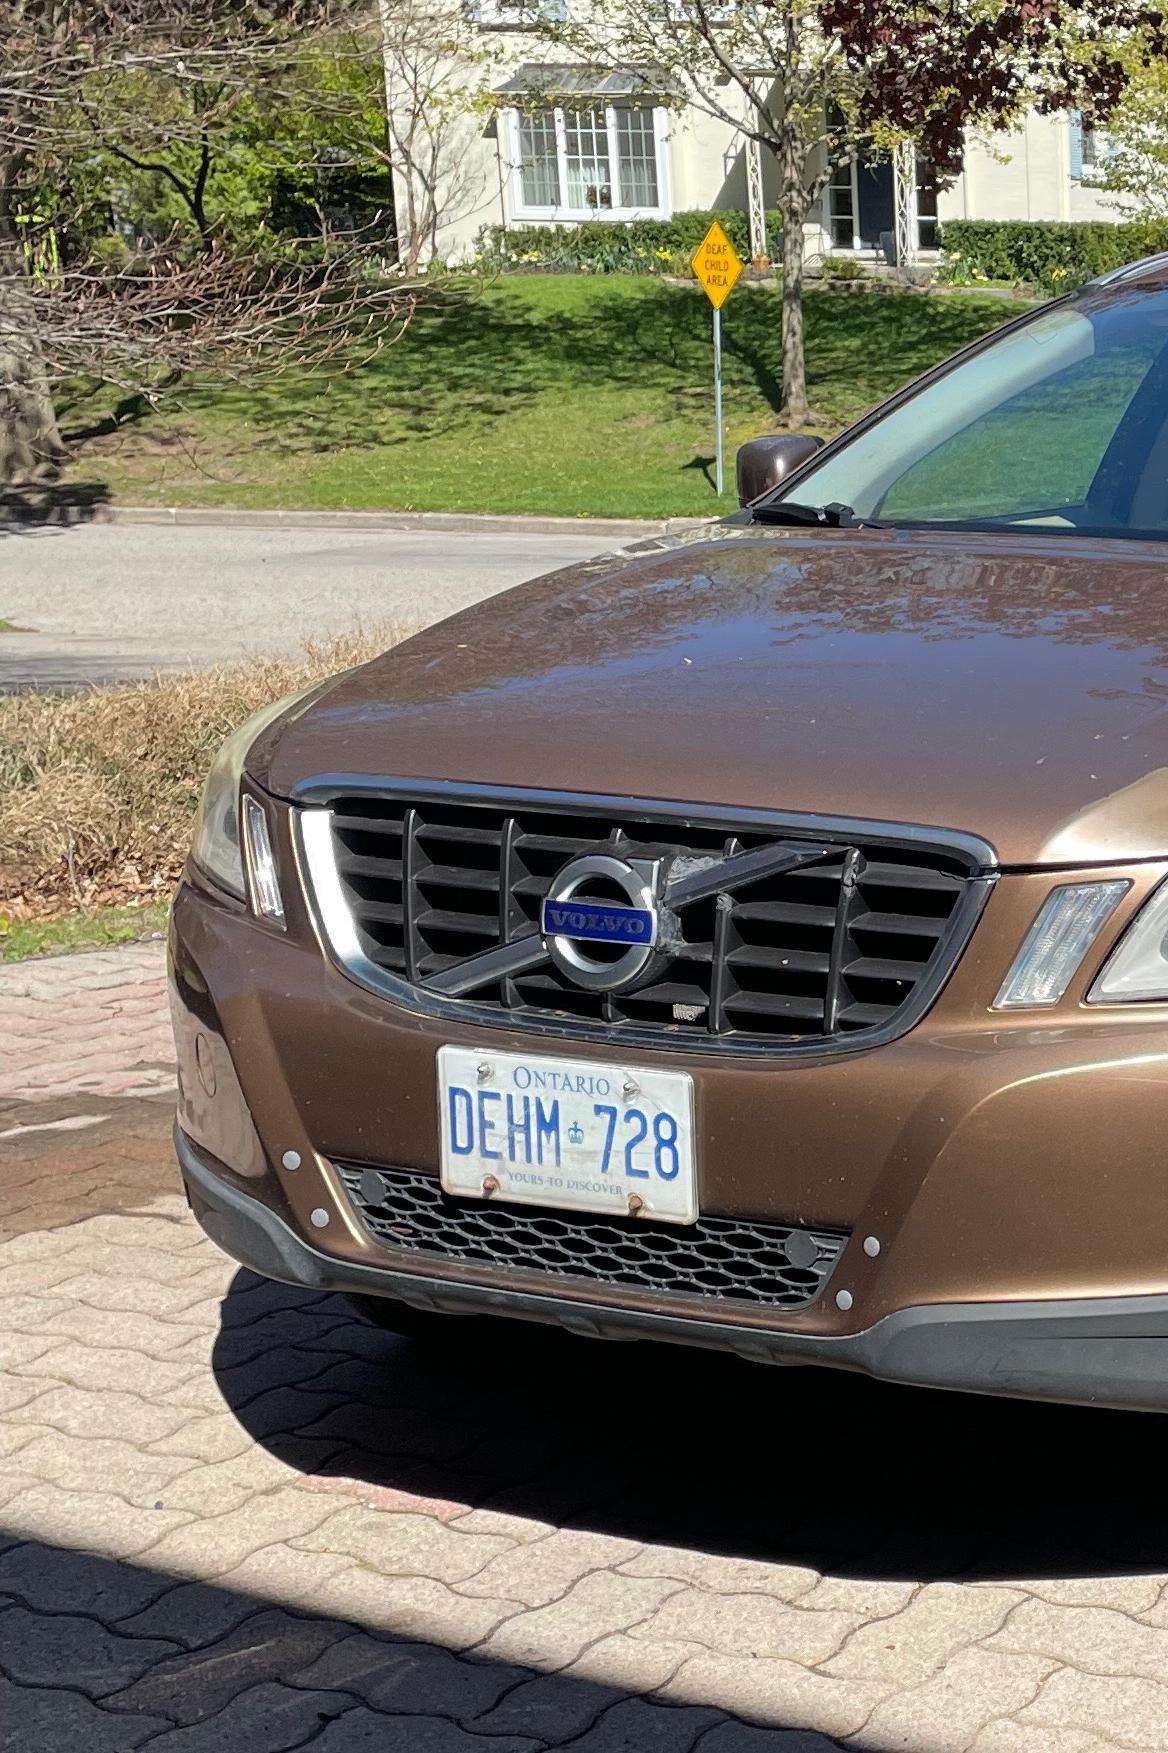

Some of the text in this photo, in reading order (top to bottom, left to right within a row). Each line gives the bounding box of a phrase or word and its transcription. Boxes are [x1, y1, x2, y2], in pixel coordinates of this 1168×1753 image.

[706, 243, 727, 255] DEAF
[704, 260, 729, 271] CHILD
[706, 275, 728, 286] AREA
[551, 910, 645, 934] VOLVO
[448, 1086, 679, 1181] DEHM 728
[507, 1171, 623, 1195] YOURS TO DISCOVER
